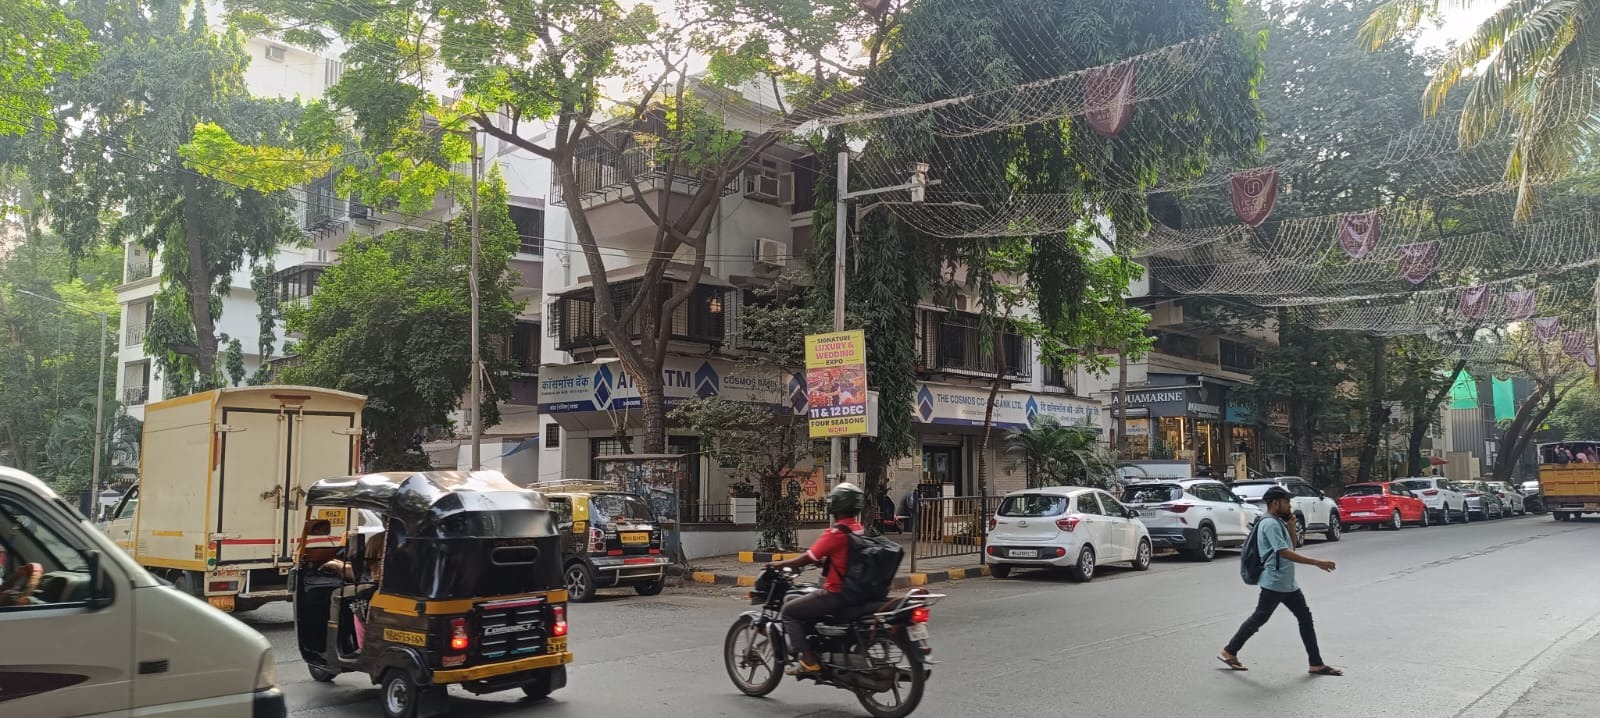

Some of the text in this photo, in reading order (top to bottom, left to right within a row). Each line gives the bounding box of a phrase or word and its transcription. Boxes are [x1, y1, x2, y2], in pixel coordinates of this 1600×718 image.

[816, 335, 851, 343] SIGNATURE
[815, 341, 854, 351] LUXURY &
[815, 350, 855, 360] WEDDING
[825, 358, 844, 366] EXPO
[723, 376, 757, 386] COSMOS
[937, 393, 949, 403] THE
[950, 394, 976, 406] COSMOS
[995, 399, 1011, 409] BANK
[1012, 401, 1023, 410] LTD.
[1112, 392, 1183, 405] AUAMARINE
[810, 405, 864, 418] 11 & 12 DEC
[831, 417, 864, 426] SEASONS
